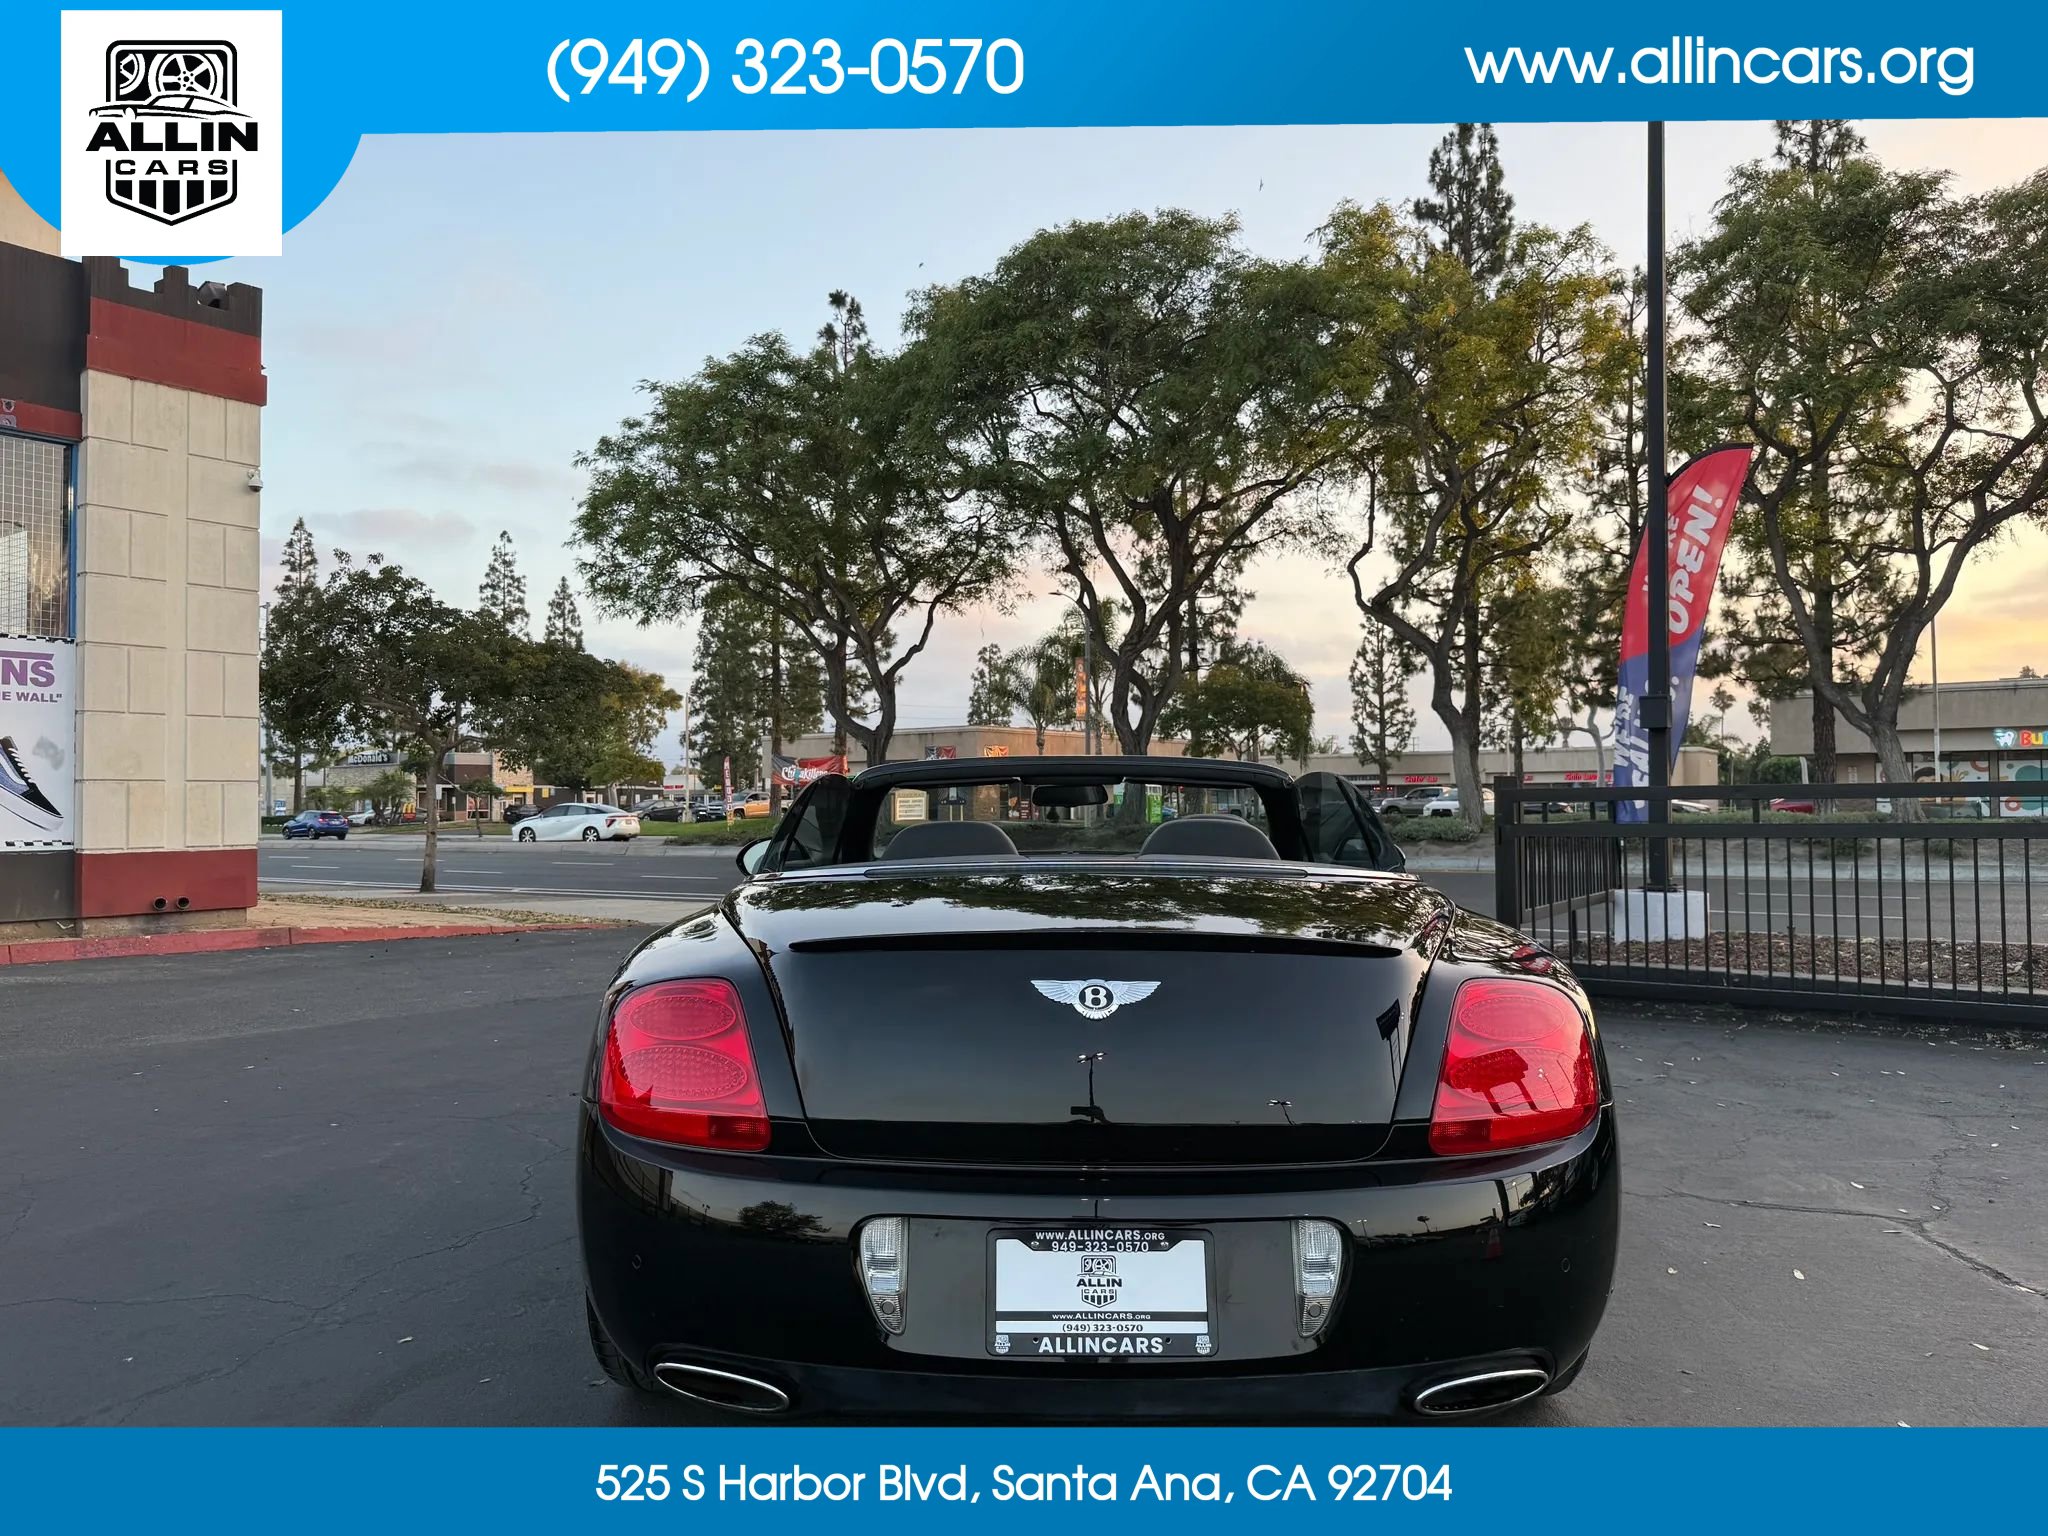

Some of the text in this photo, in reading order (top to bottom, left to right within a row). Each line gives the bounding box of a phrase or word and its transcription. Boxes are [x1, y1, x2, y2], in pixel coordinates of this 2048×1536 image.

[1668, 484, 1723, 635] OPEN!
[1051, 1241, 1149, 1253] 949-323-0570
[1076, 1278, 1123, 1288] ALLIN
[1062, 1323, 1144, 1333] (949) 323-0570
[1038, 1336, 1164, 1354] ALLINCARS
